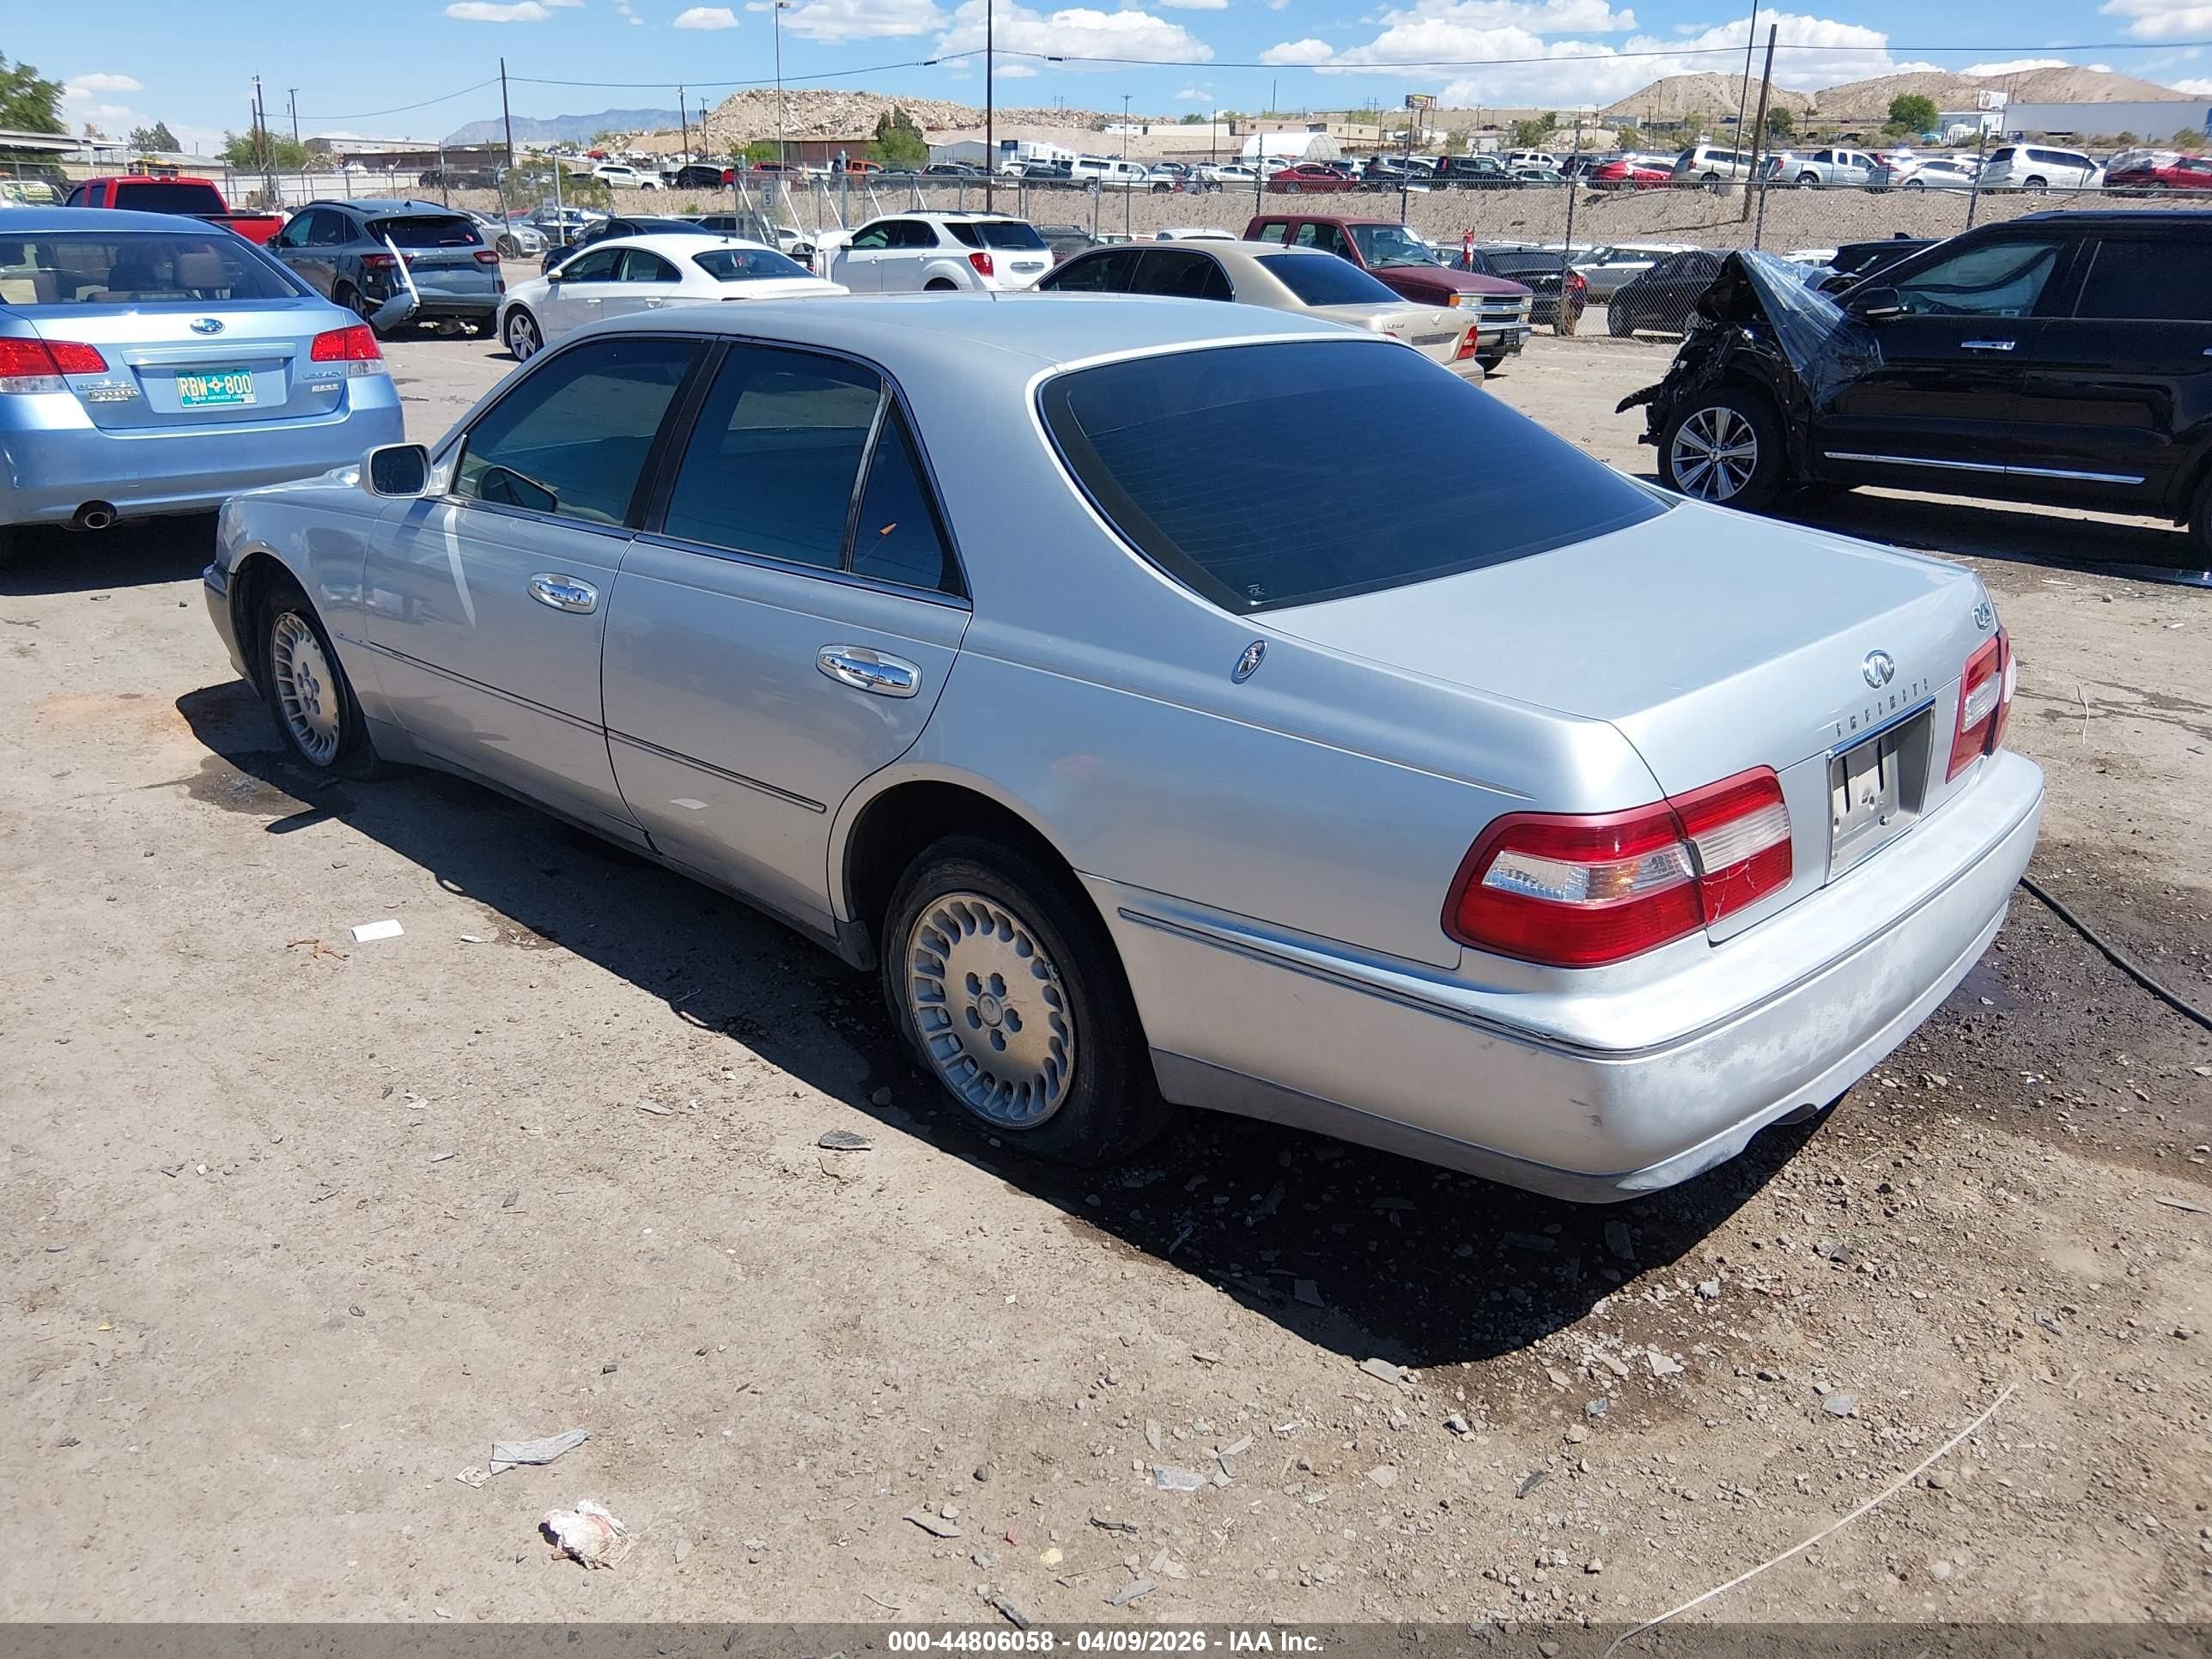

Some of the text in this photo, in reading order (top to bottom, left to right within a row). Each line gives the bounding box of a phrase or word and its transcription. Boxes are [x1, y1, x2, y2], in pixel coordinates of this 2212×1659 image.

[765, 194, 771, 205] 5
[178, 374, 252, 398] RBW 800
